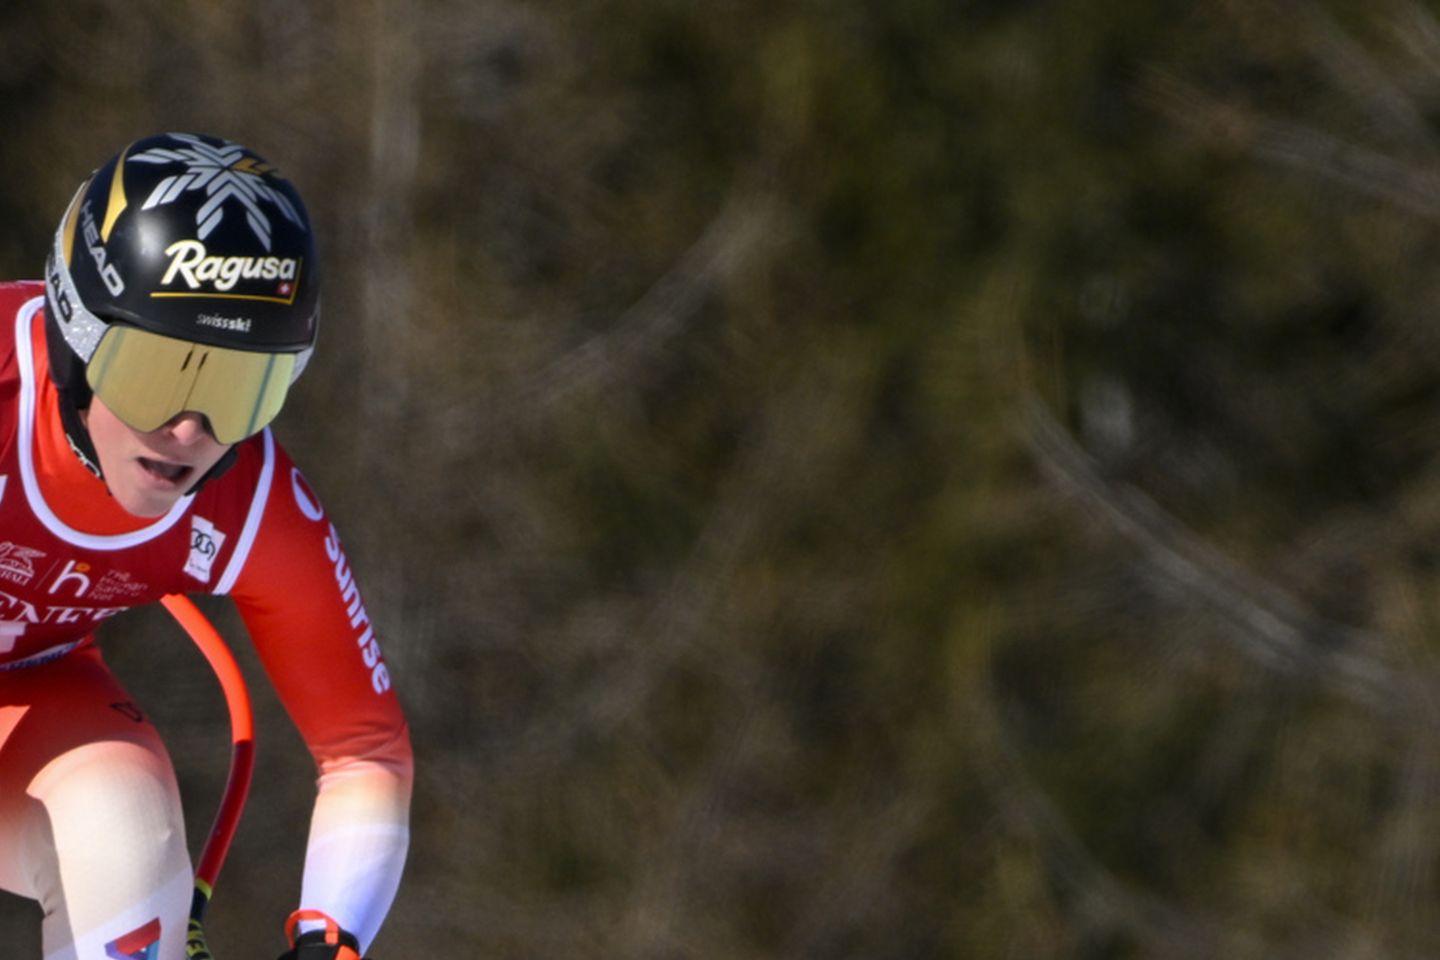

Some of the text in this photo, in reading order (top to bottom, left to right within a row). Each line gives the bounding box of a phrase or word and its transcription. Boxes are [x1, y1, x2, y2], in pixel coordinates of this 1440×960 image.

[80, 199, 126, 297] HEAD
[161, 239, 296, 291] Ragusa
[324, 521, 392, 695] sunrise
